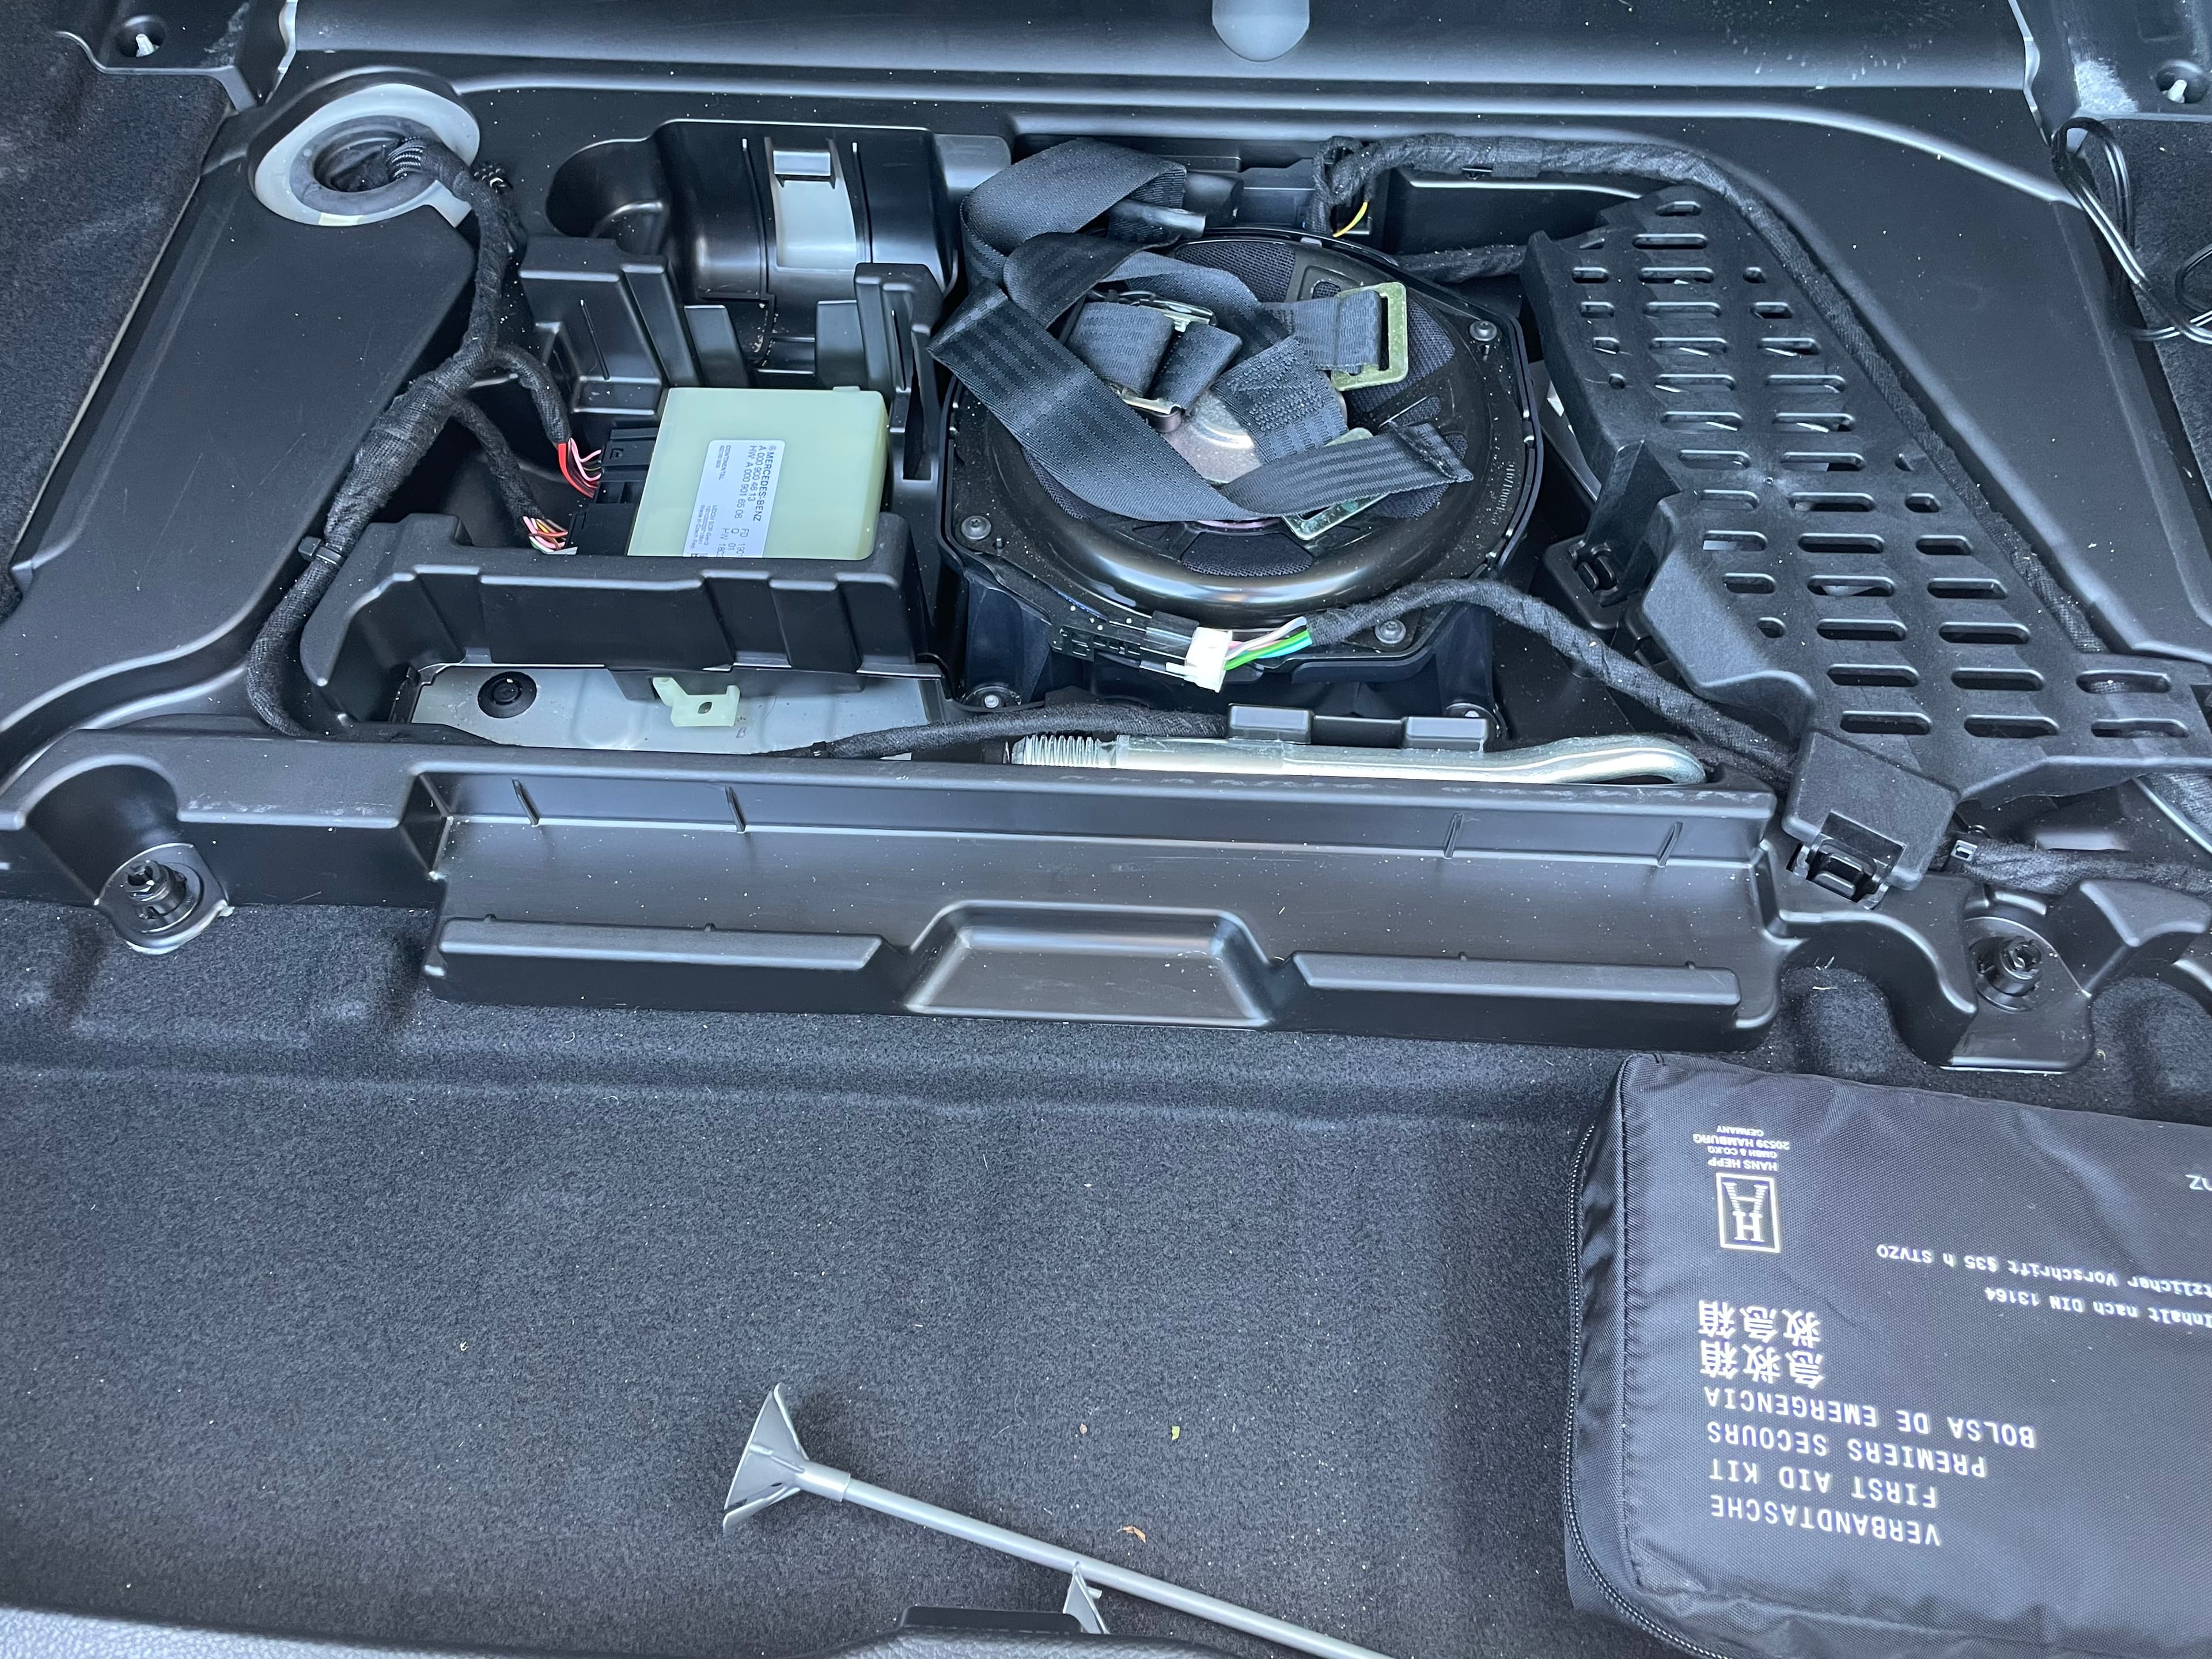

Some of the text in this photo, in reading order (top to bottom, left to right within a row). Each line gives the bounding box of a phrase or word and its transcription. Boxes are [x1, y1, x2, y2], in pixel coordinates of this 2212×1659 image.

[755, 453, 765, 465] 000
[742, 469, 752, 482] 000
[752, 467, 762, 480] 900
[739, 484, 748, 496] 901
[753, 452, 775, 521] MERCEDES-BENZ
[737, 499, 745, 508] 65
[748, 494, 756, 502] 13
[1716, 1125, 1764, 1137] GERMANY
[1692, 1133, 1790, 1150] 20539 HAMBURG
[1748, 1149, 1778, 1159] GMBH
[1707, 1157, 1778, 1171] HANS HEPP
[1876, 1244, 1932, 1263] STVZO
[1943, 1252, 1955, 1266] h
[2008, 1260, 2118, 1286] Vorschrift
[1984, 1287, 2212, 1328] Inhalt nach DIN 13164
[1698, 1300, 1820, 1348] 救急箱
[1700, 1340, 1825, 1389] 急救箱
[1704, 1385, 2036, 1449] BOLSA DE EMERGENCIA
[1707, 1421, 1986, 1478] PREMIERS SECOURS
[1709, 1458, 1937, 1509] FIRST AID KIT
[1711, 1494, 1941, 1546] VERBANDTASCHE
